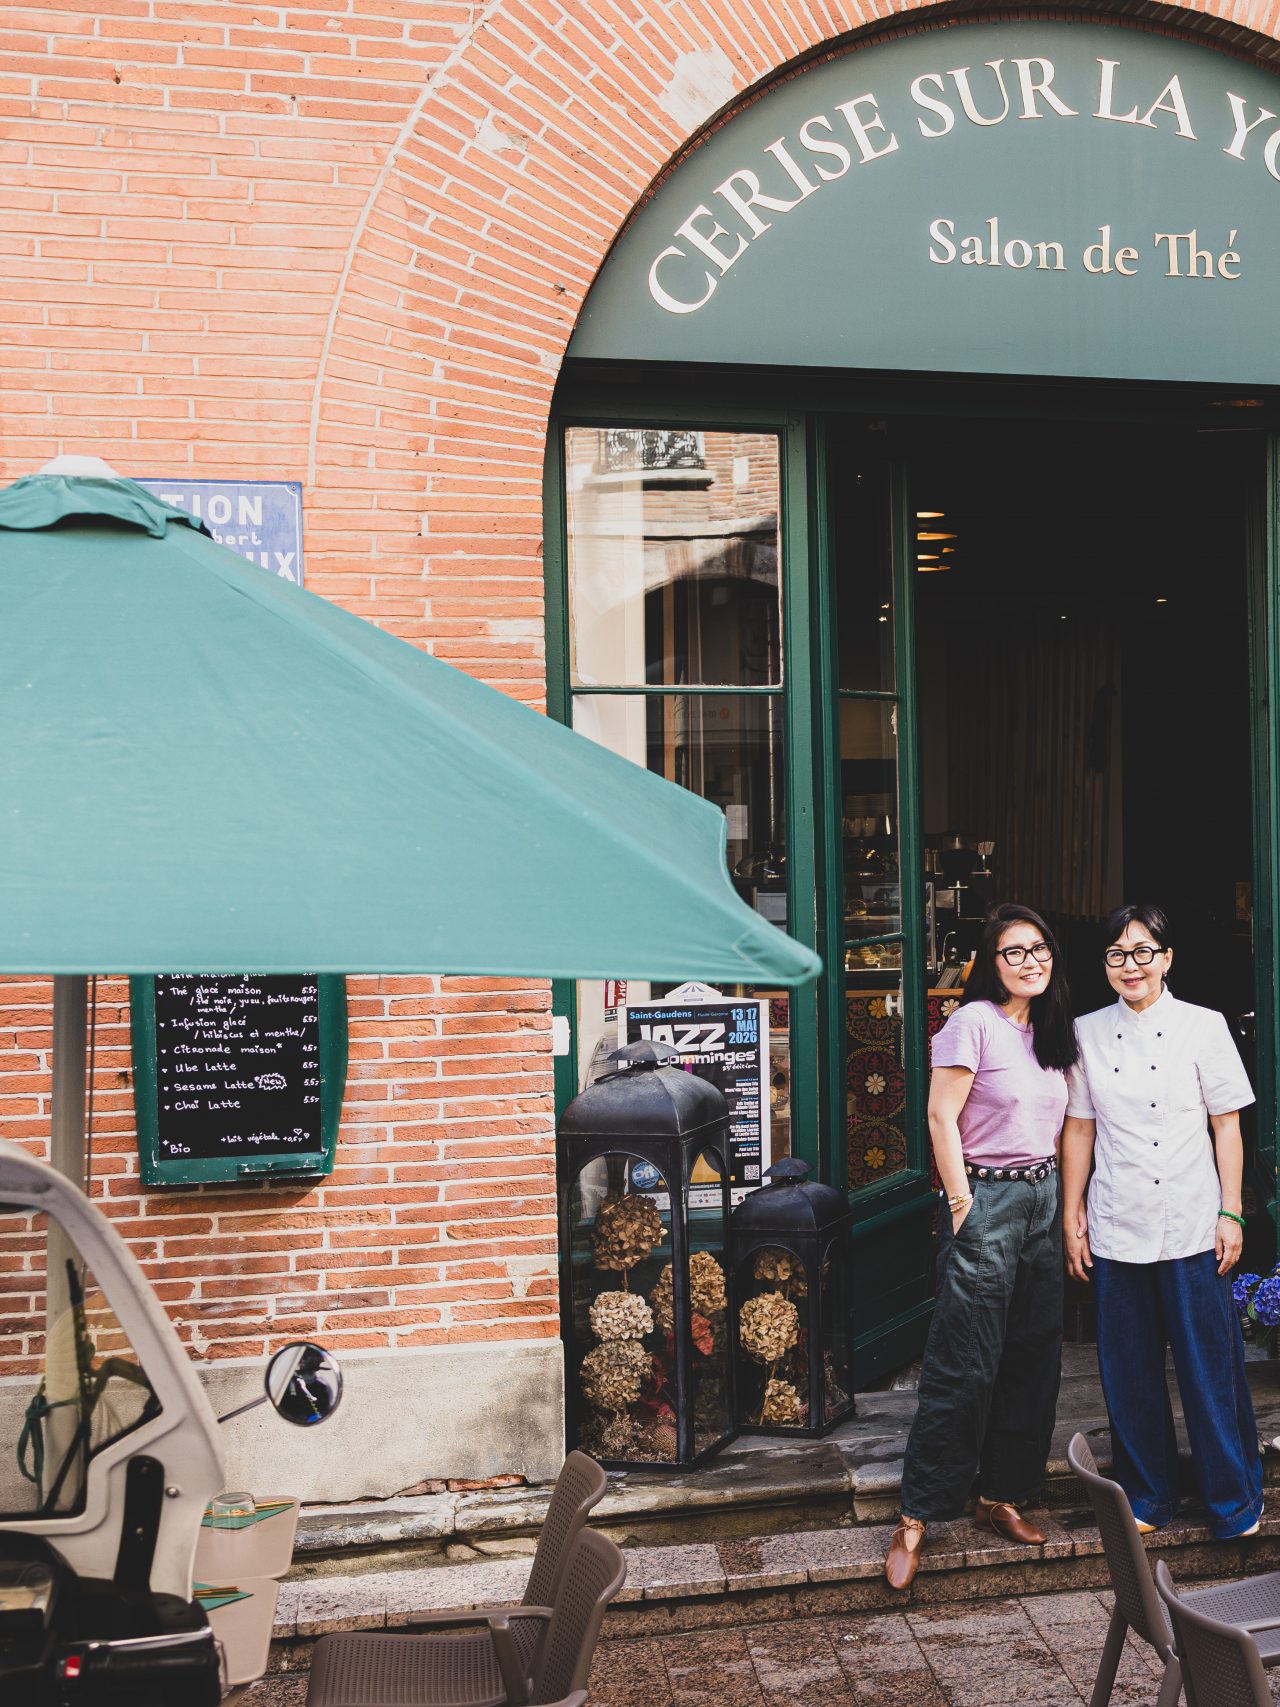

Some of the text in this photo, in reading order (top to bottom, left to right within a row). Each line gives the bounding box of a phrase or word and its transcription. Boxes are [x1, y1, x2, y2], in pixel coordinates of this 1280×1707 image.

[648, 93, 899, 314] CERISE
[910, 58, 1078, 138] SUR
[1092, 58, 1198, 141] LA
[928, 217, 1241, 279] Salon de Thé
[169, 986, 188, 996] Thé
[195, 983, 219, 998] glacé
[228, 984, 262, 995] maison
[629, 1010, 692, 1020] Saint-Gaudens
[171, 1018, 216, 1030] Infusion
[223, 1016, 246, 1030] glacé
[736, 1019, 758, 1031] MAI
[203, 1029, 243, 1039] hibiscus
[249, 1029, 259, 1037] et
[728, 1032, 758, 1044] 2026
[175, 1063, 199, 1072] Ube
[205, 1062, 237, 1071] Latte
[174, 1083, 217, 1091] Sesame
[224, 1080, 256, 1090] Latte
[175, 1100, 199, 1110] Chai
[208, 1099, 241, 1110] Latte
[170, 1143, 191, 1154] Bio
